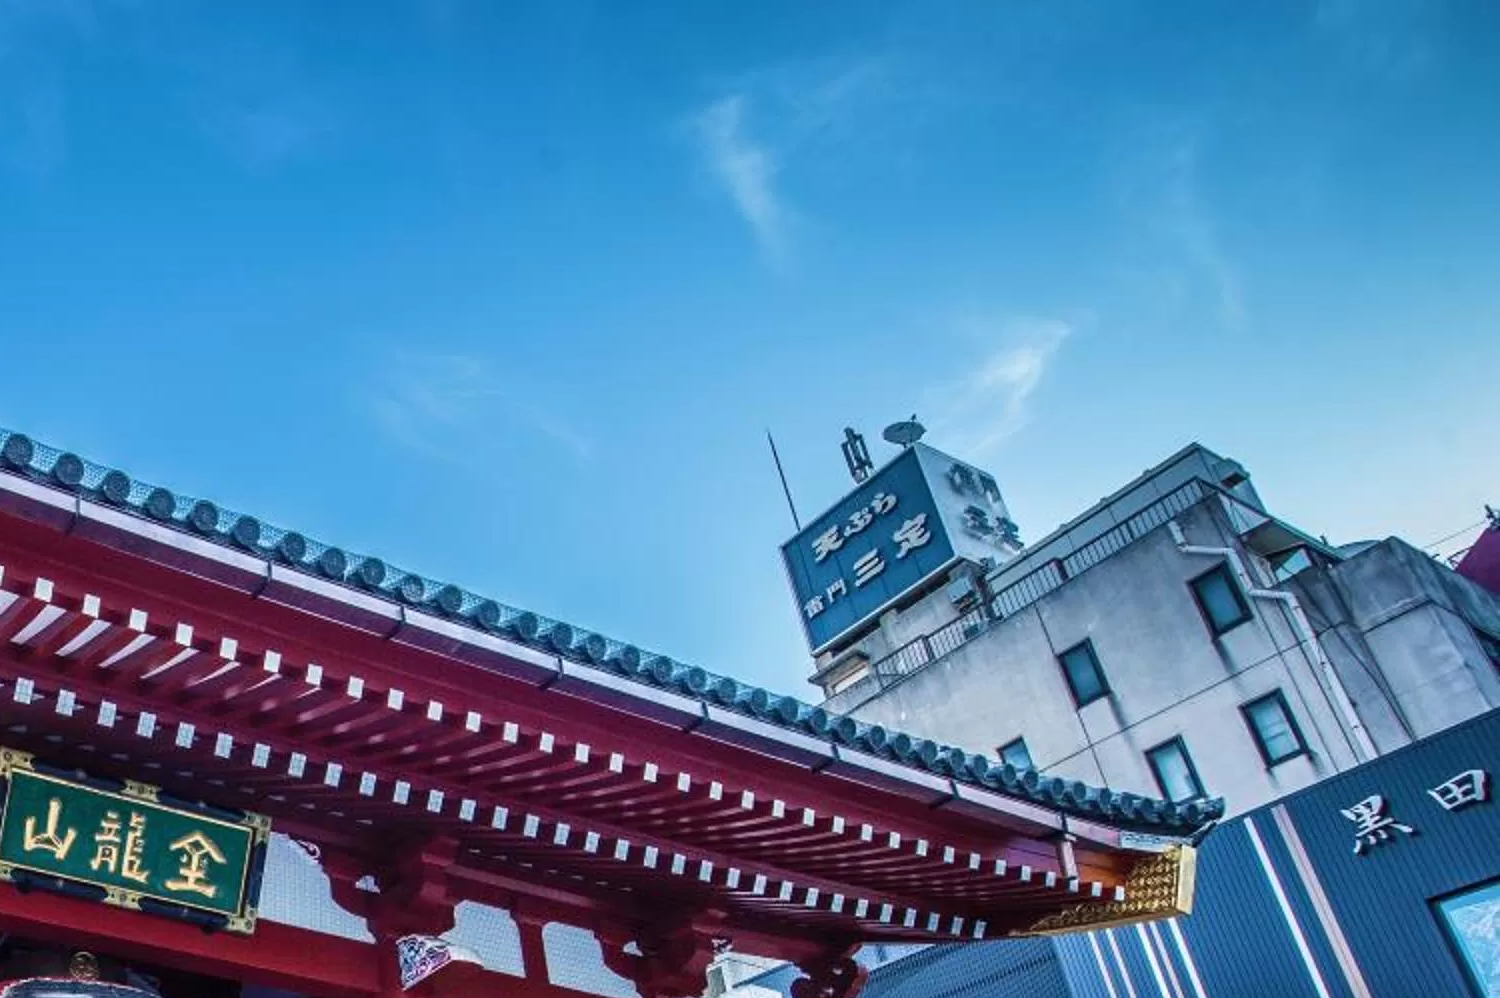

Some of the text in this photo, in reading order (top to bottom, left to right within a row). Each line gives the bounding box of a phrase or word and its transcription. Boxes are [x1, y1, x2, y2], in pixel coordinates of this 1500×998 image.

[812, 492, 897, 563] 天ぷら
[1340, 769, 1486, 854] 黒田
